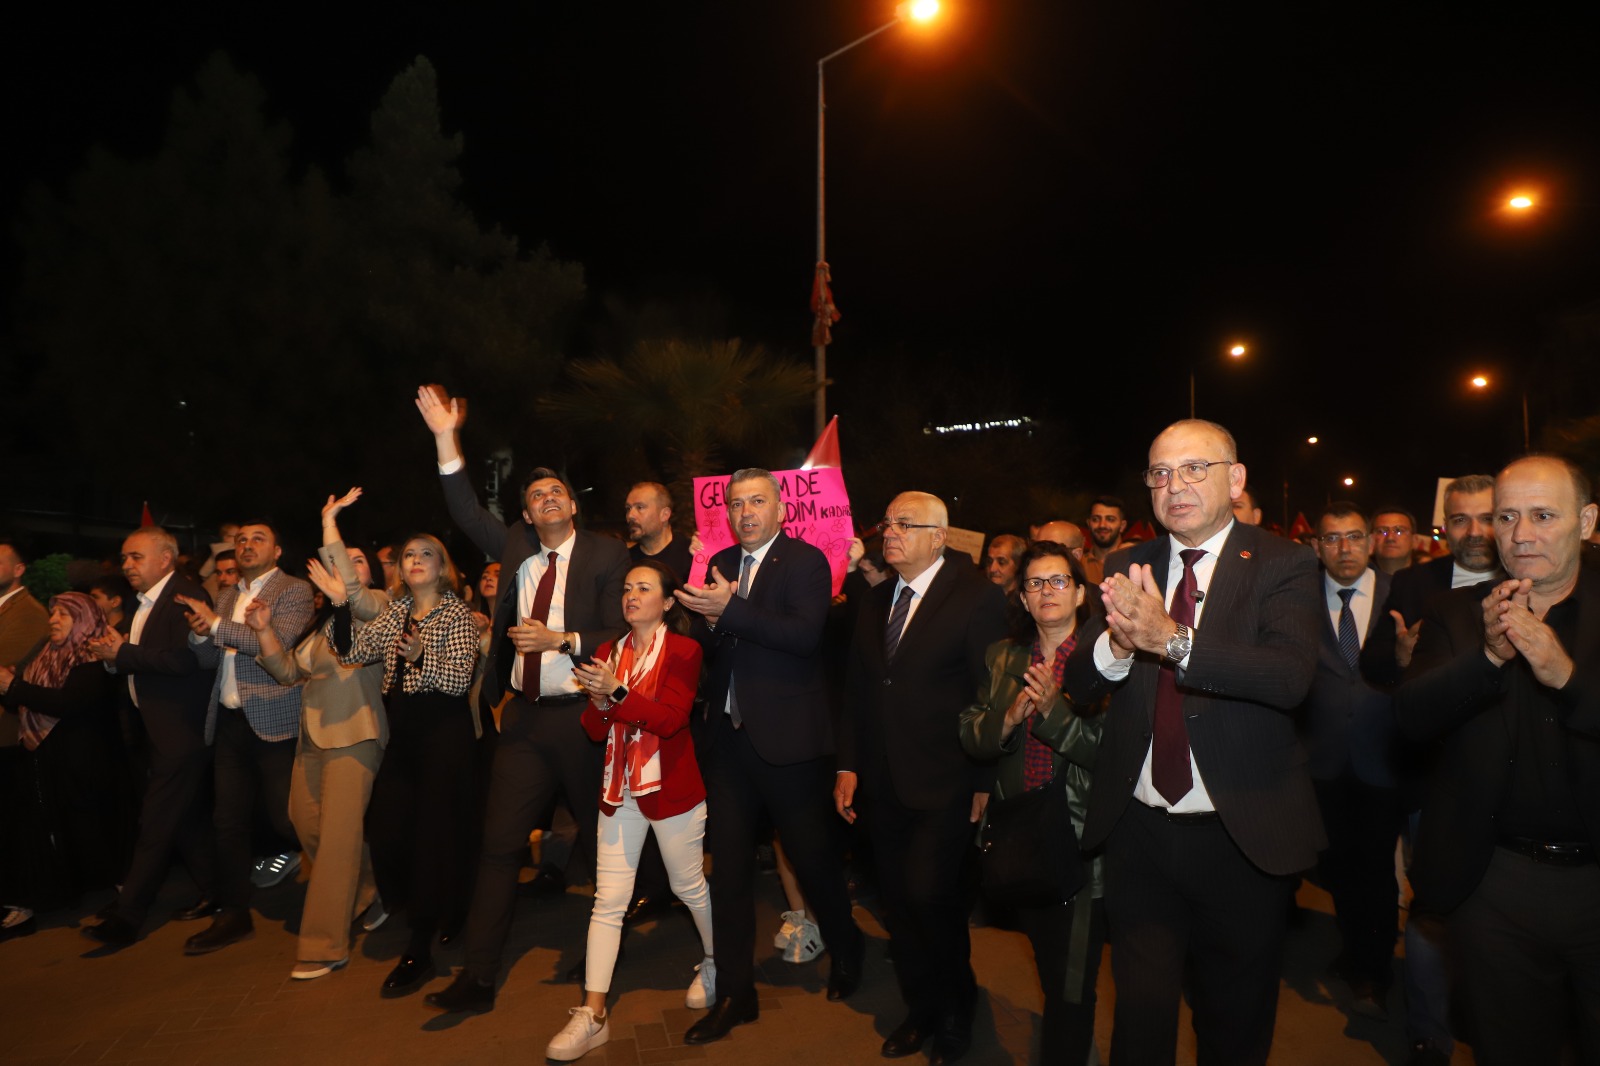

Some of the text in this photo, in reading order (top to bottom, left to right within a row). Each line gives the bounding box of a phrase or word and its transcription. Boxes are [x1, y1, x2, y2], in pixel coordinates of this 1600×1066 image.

[796, 471, 821, 497] DE
[783, 499, 817, 523] DİM
[783, 526, 806, 542] OK
